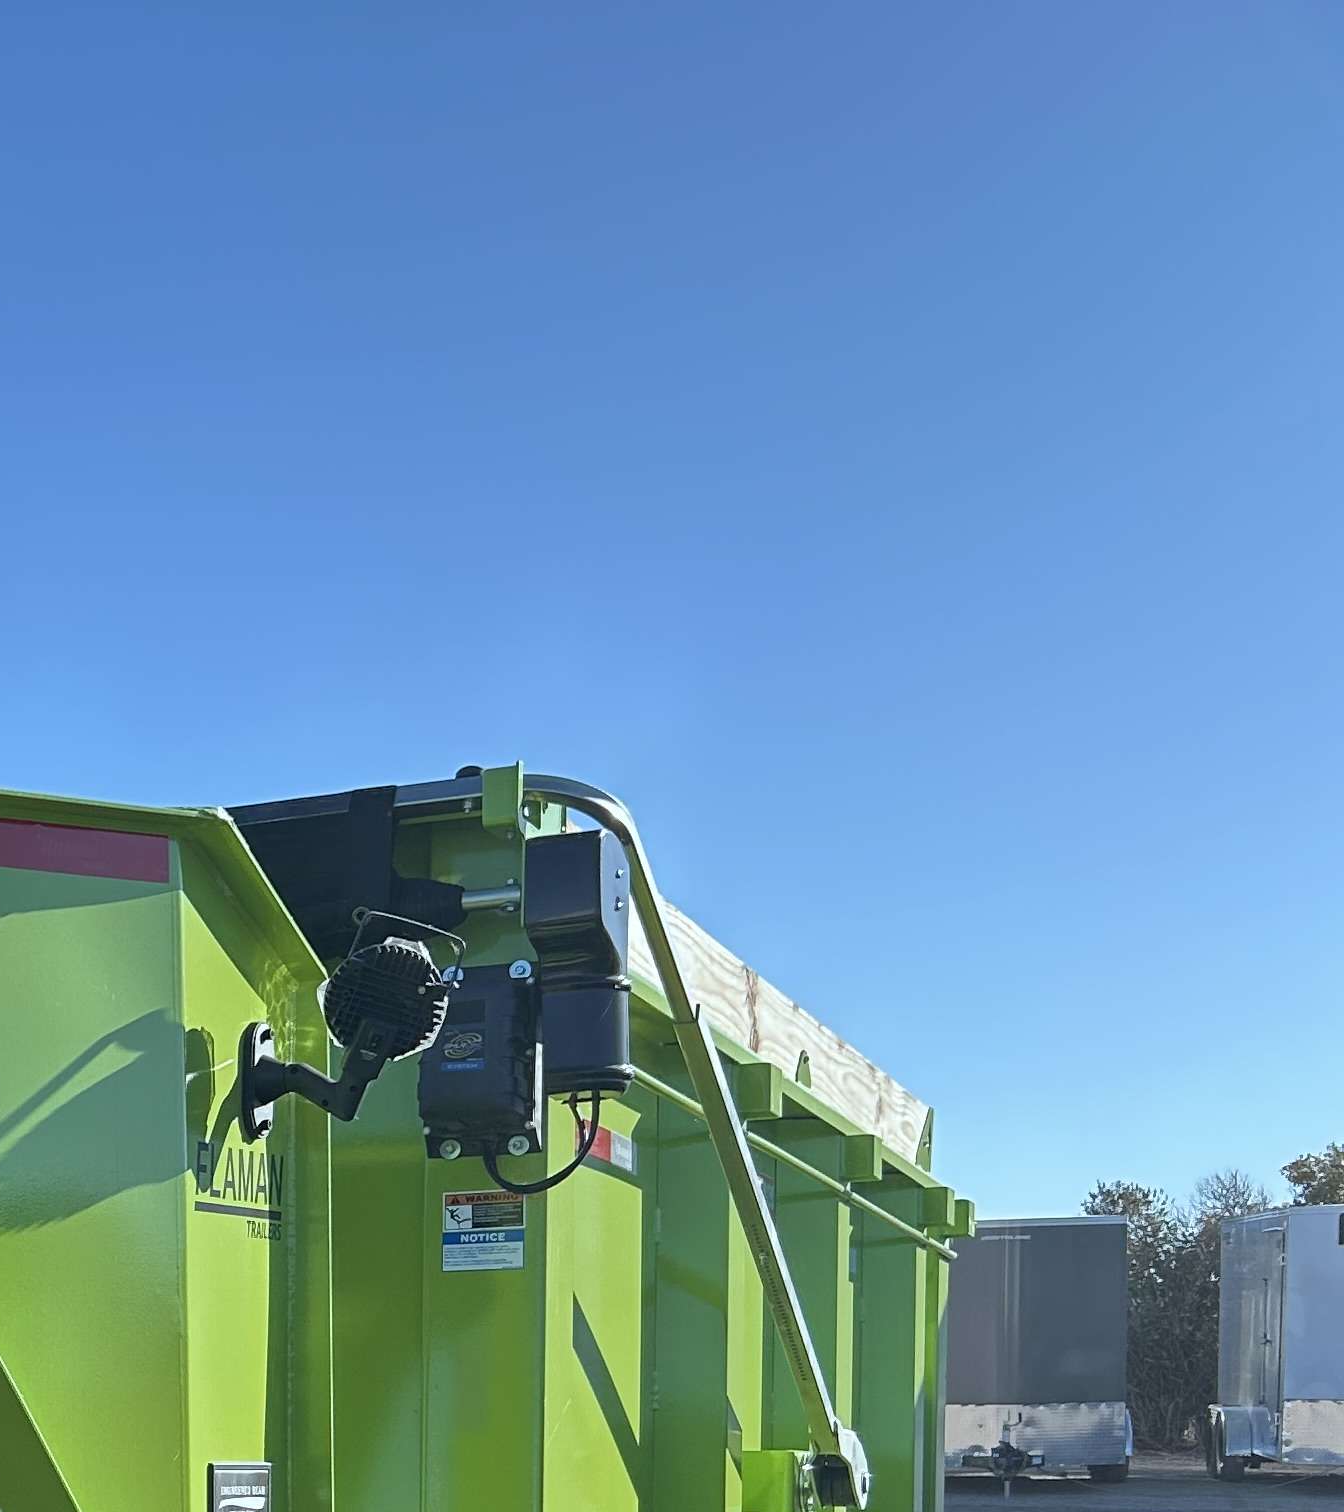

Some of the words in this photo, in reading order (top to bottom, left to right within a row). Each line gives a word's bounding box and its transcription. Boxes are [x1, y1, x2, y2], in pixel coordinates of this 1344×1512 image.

[196, 1141, 284, 1207] FLAMAN
[465, 1192, 519, 1203] WARNING
[460, 1232, 506, 1243] NOTICE
